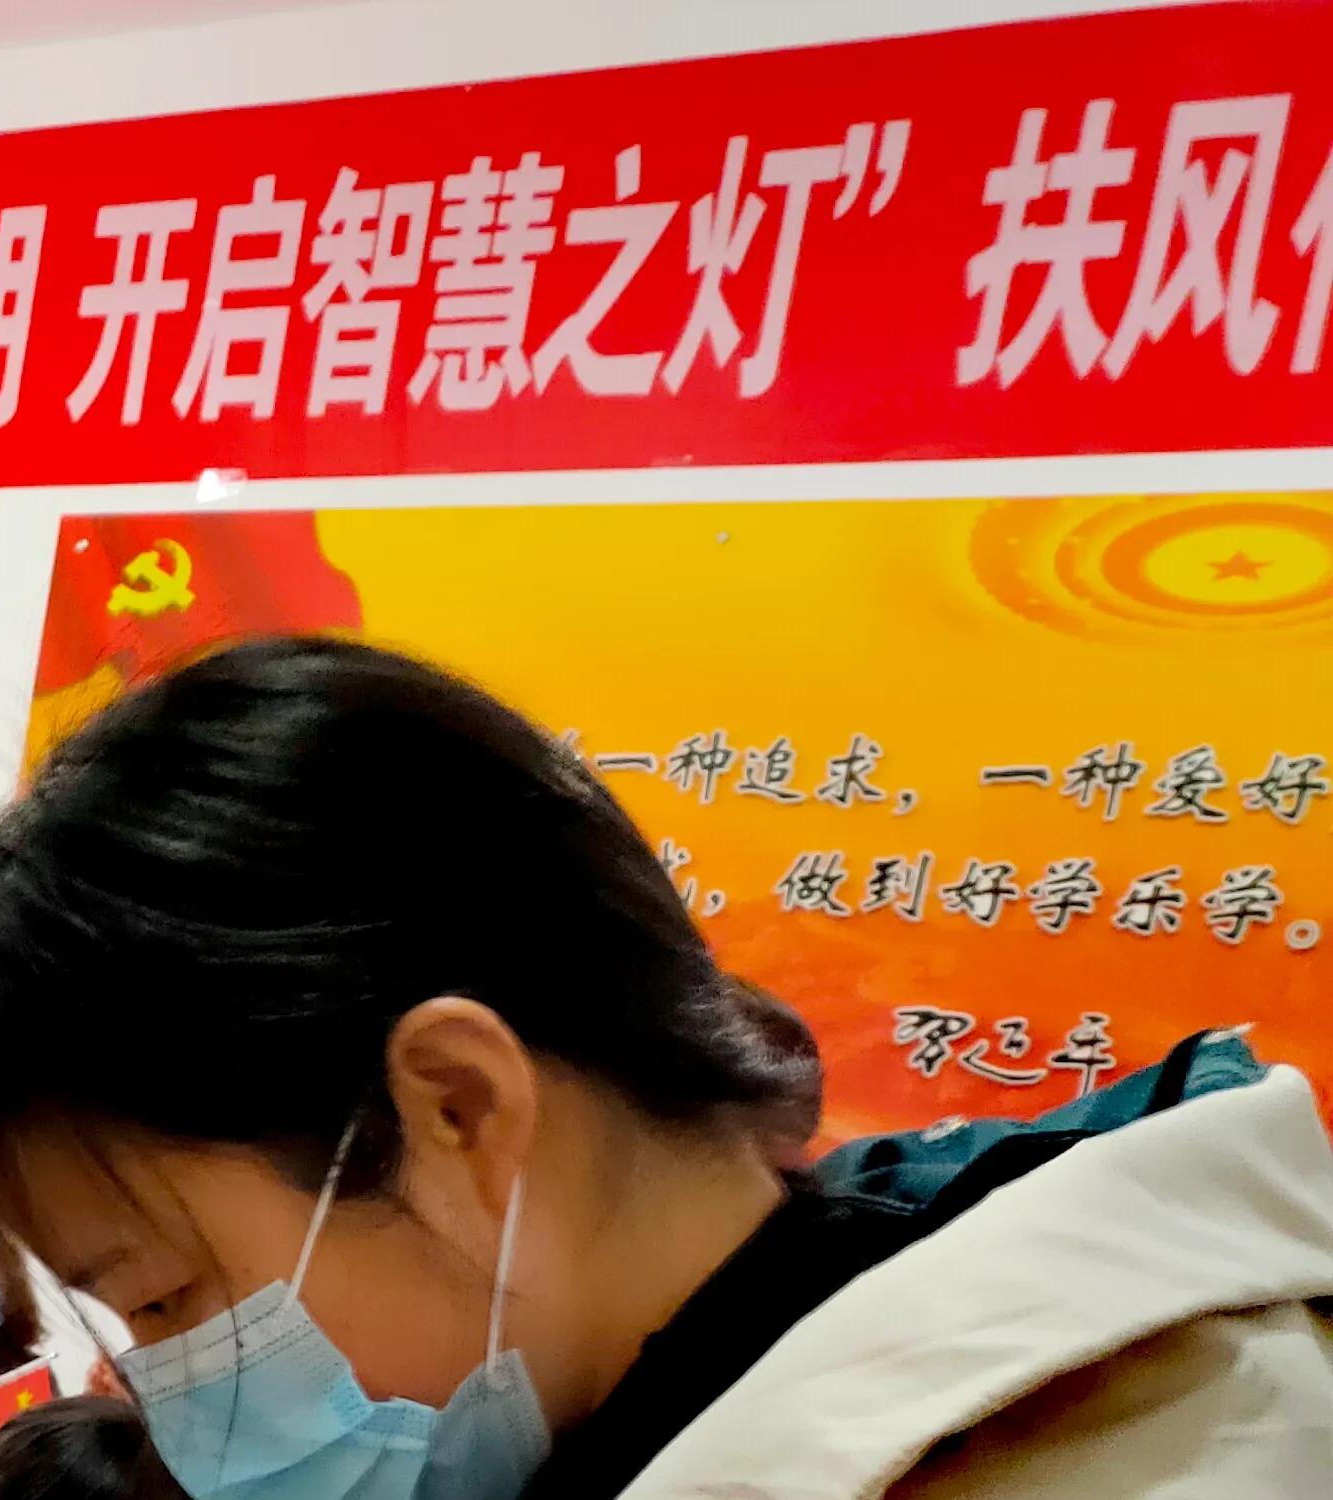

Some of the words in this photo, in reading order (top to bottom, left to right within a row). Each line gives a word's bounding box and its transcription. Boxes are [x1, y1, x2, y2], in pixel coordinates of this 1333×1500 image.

[66, 119, 912, 427] 开启智慧之灯”
